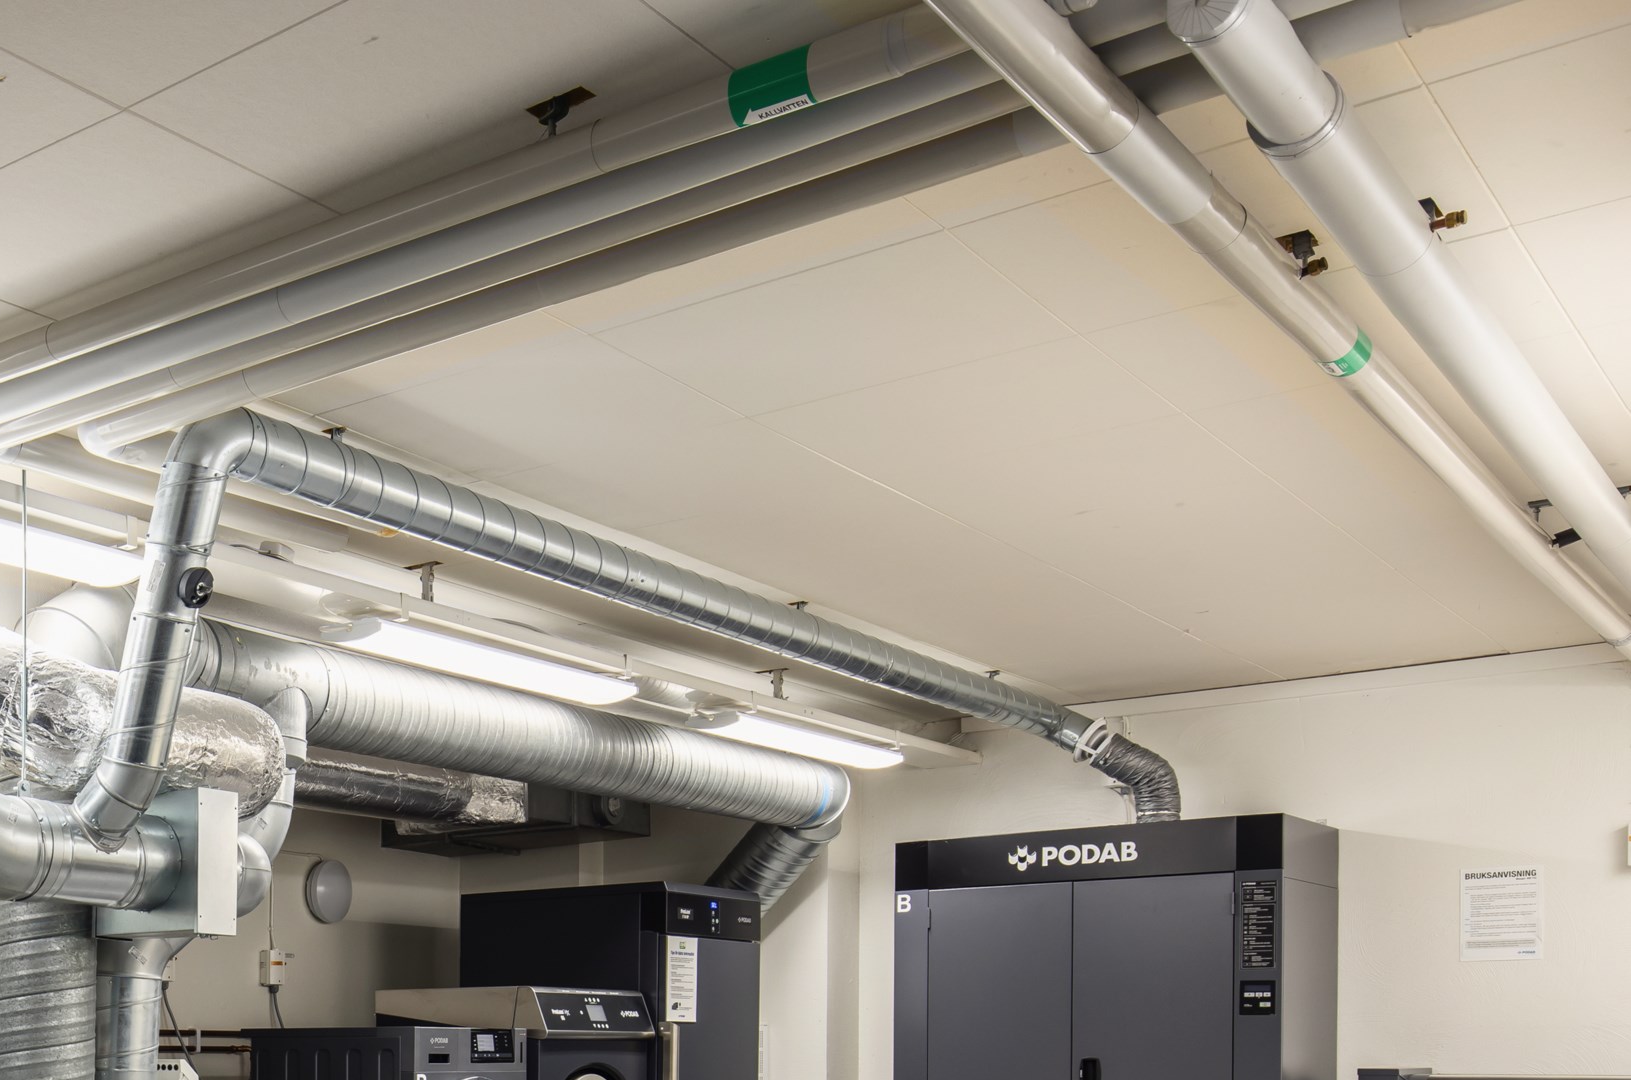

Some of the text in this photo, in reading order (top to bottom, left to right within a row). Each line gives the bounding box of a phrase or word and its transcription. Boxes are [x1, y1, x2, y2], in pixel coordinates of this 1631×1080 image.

[758, 98, 809, 119] KALLVATTEN
[1041, 841, 1138, 867] PODAB
[1464, 869, 1537, 880] BRUKSANVISNING
[897, 894, 911, 913] B
